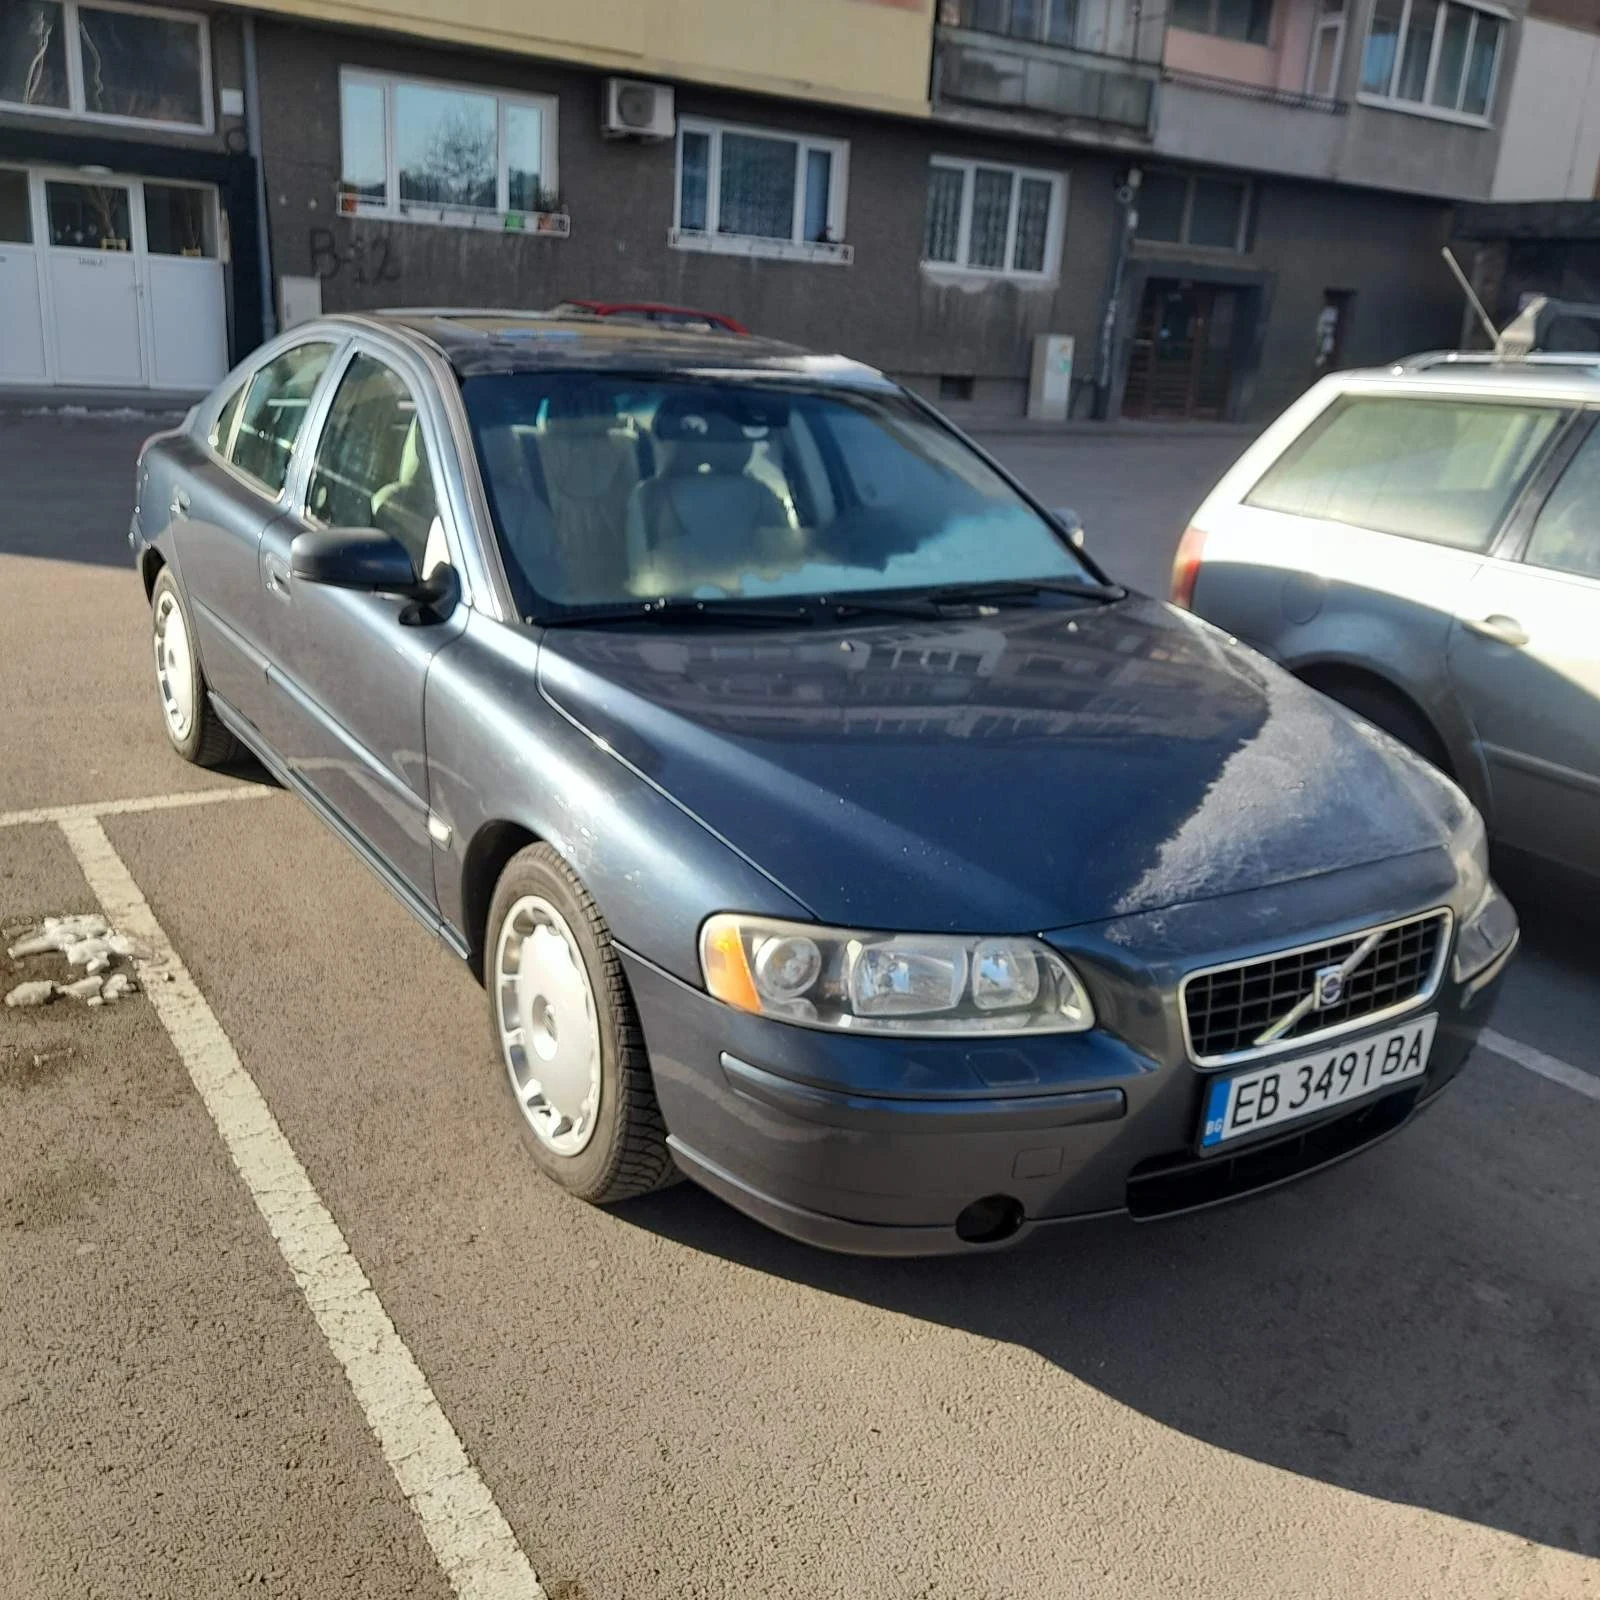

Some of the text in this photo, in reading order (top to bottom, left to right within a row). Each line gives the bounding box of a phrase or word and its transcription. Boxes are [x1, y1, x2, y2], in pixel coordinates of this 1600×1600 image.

[1230, 1029, 1423, 1130] EB 3491 BA
[1205, 1118, 1223, 1137] BG
